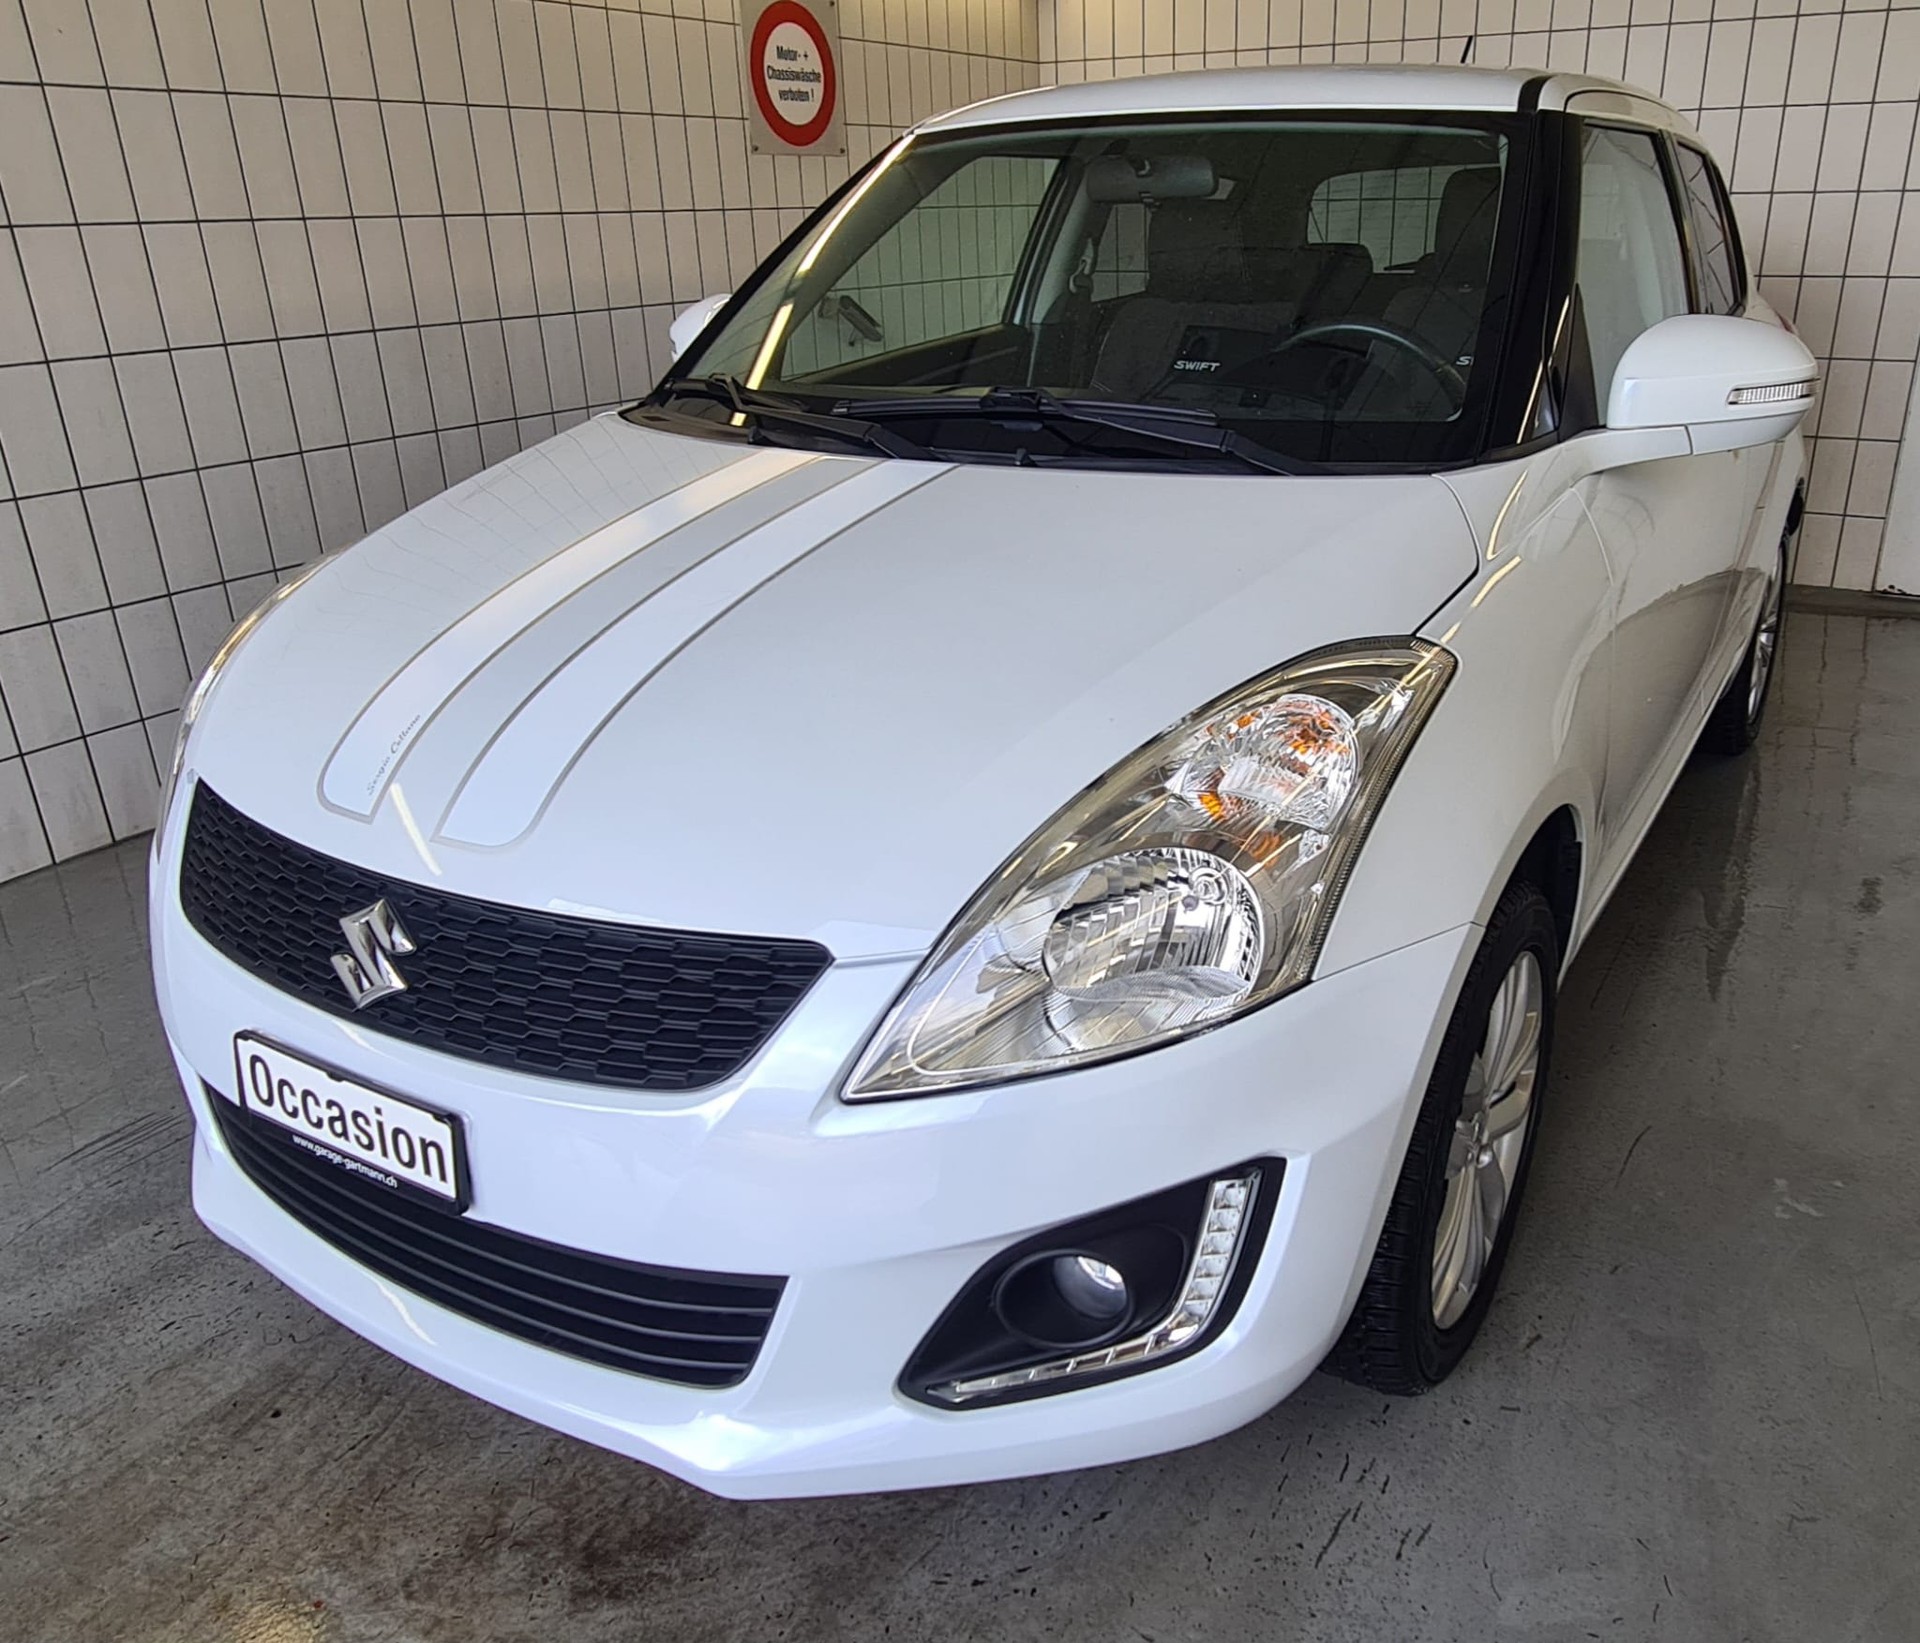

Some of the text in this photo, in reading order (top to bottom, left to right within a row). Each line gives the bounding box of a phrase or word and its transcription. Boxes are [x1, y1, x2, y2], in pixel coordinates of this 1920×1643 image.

[767, 65, 821, 83] Chassiswäsche
[778, 87, 810, 102] verboten
[1173, 360, 1221, 372] SWIFT
[249, 1054, 448, 1184] Occasion
[292, 1134, 398, 1189] www.garage-gartmann.ch
